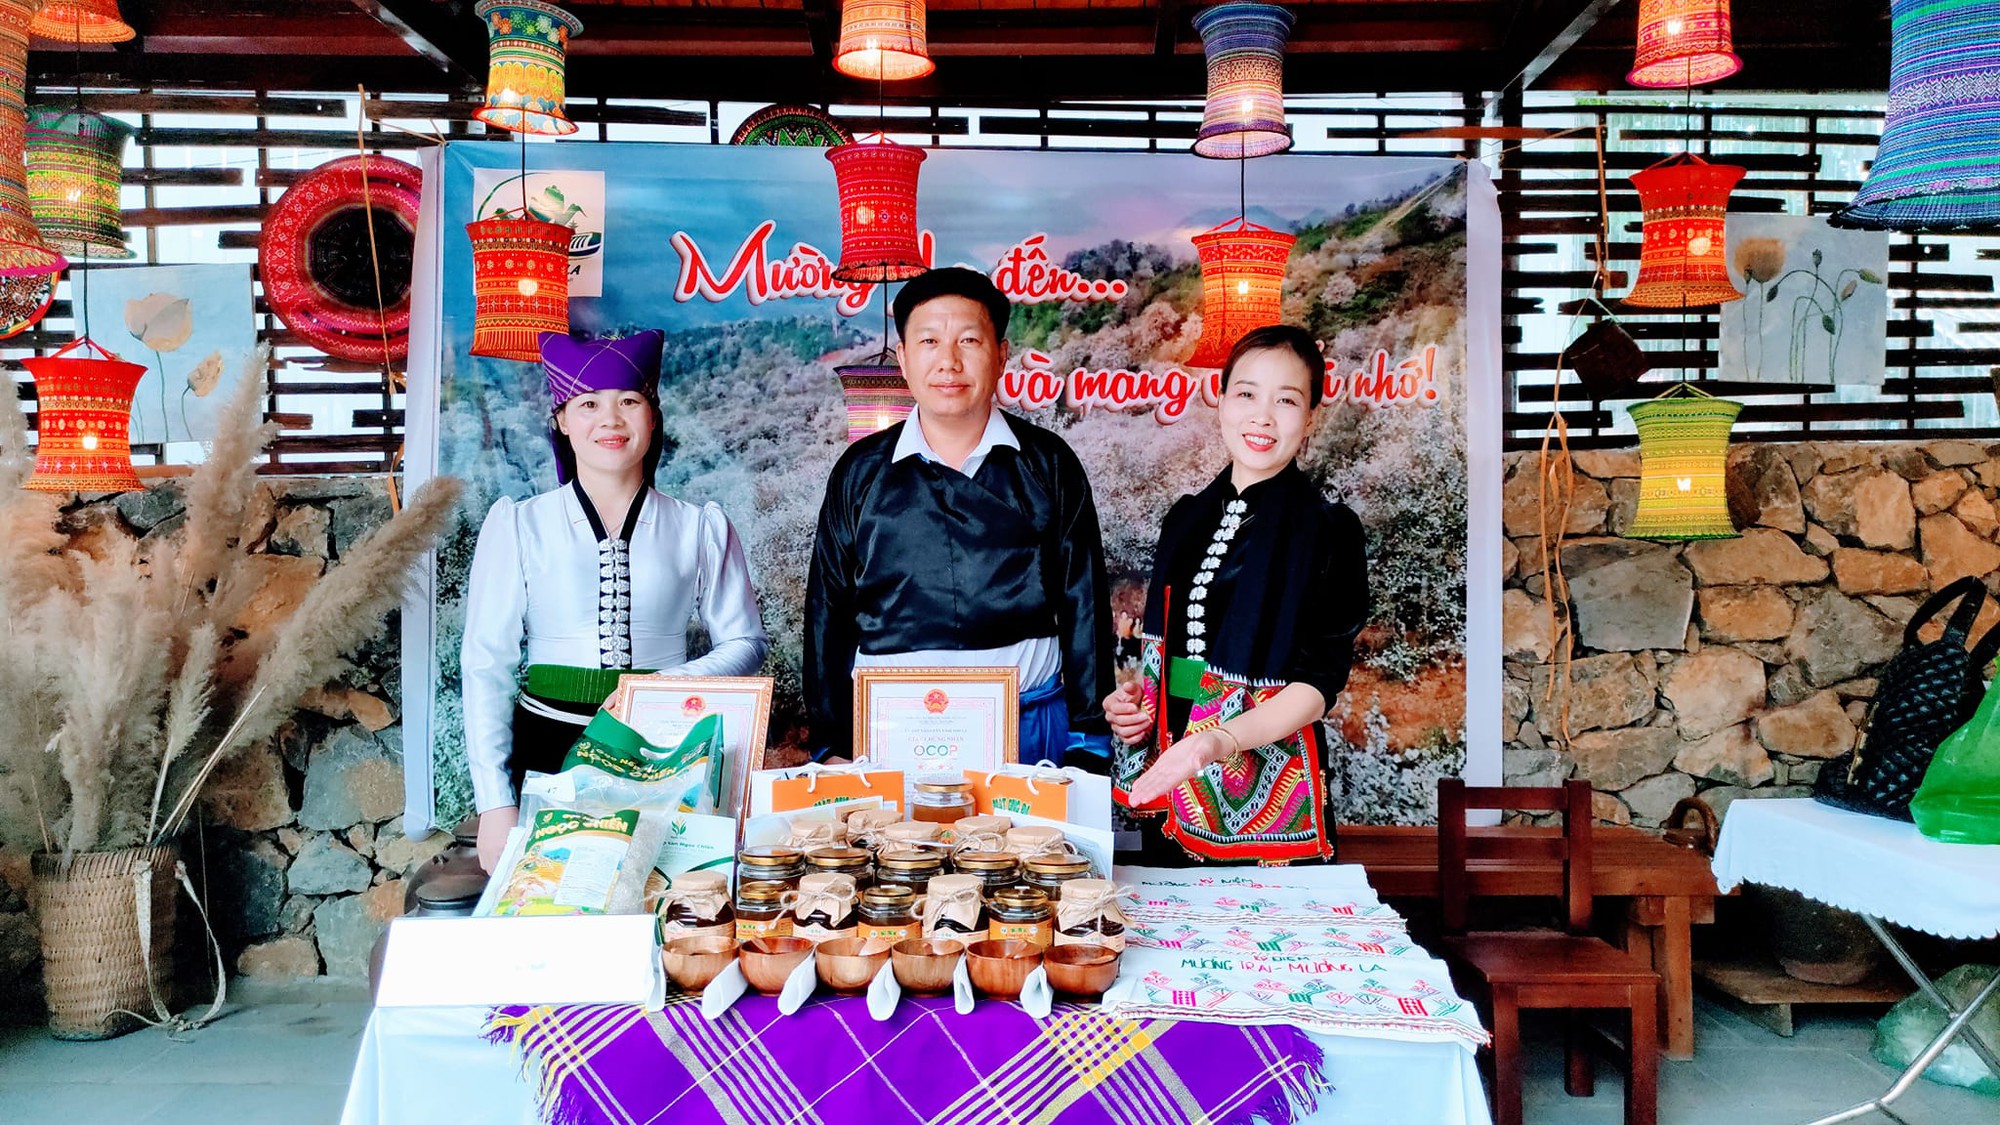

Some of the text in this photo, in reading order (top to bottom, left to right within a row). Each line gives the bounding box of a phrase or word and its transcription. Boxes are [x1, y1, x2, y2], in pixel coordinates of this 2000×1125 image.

[995, 234, 1126, 298] đến...
[1002, 352, 1062, 405] và
[1073, 369, 1194, 421] mang
[1352, 346, 1439, 405] nhớ!
[913, 744, 958, 757] OCOP
